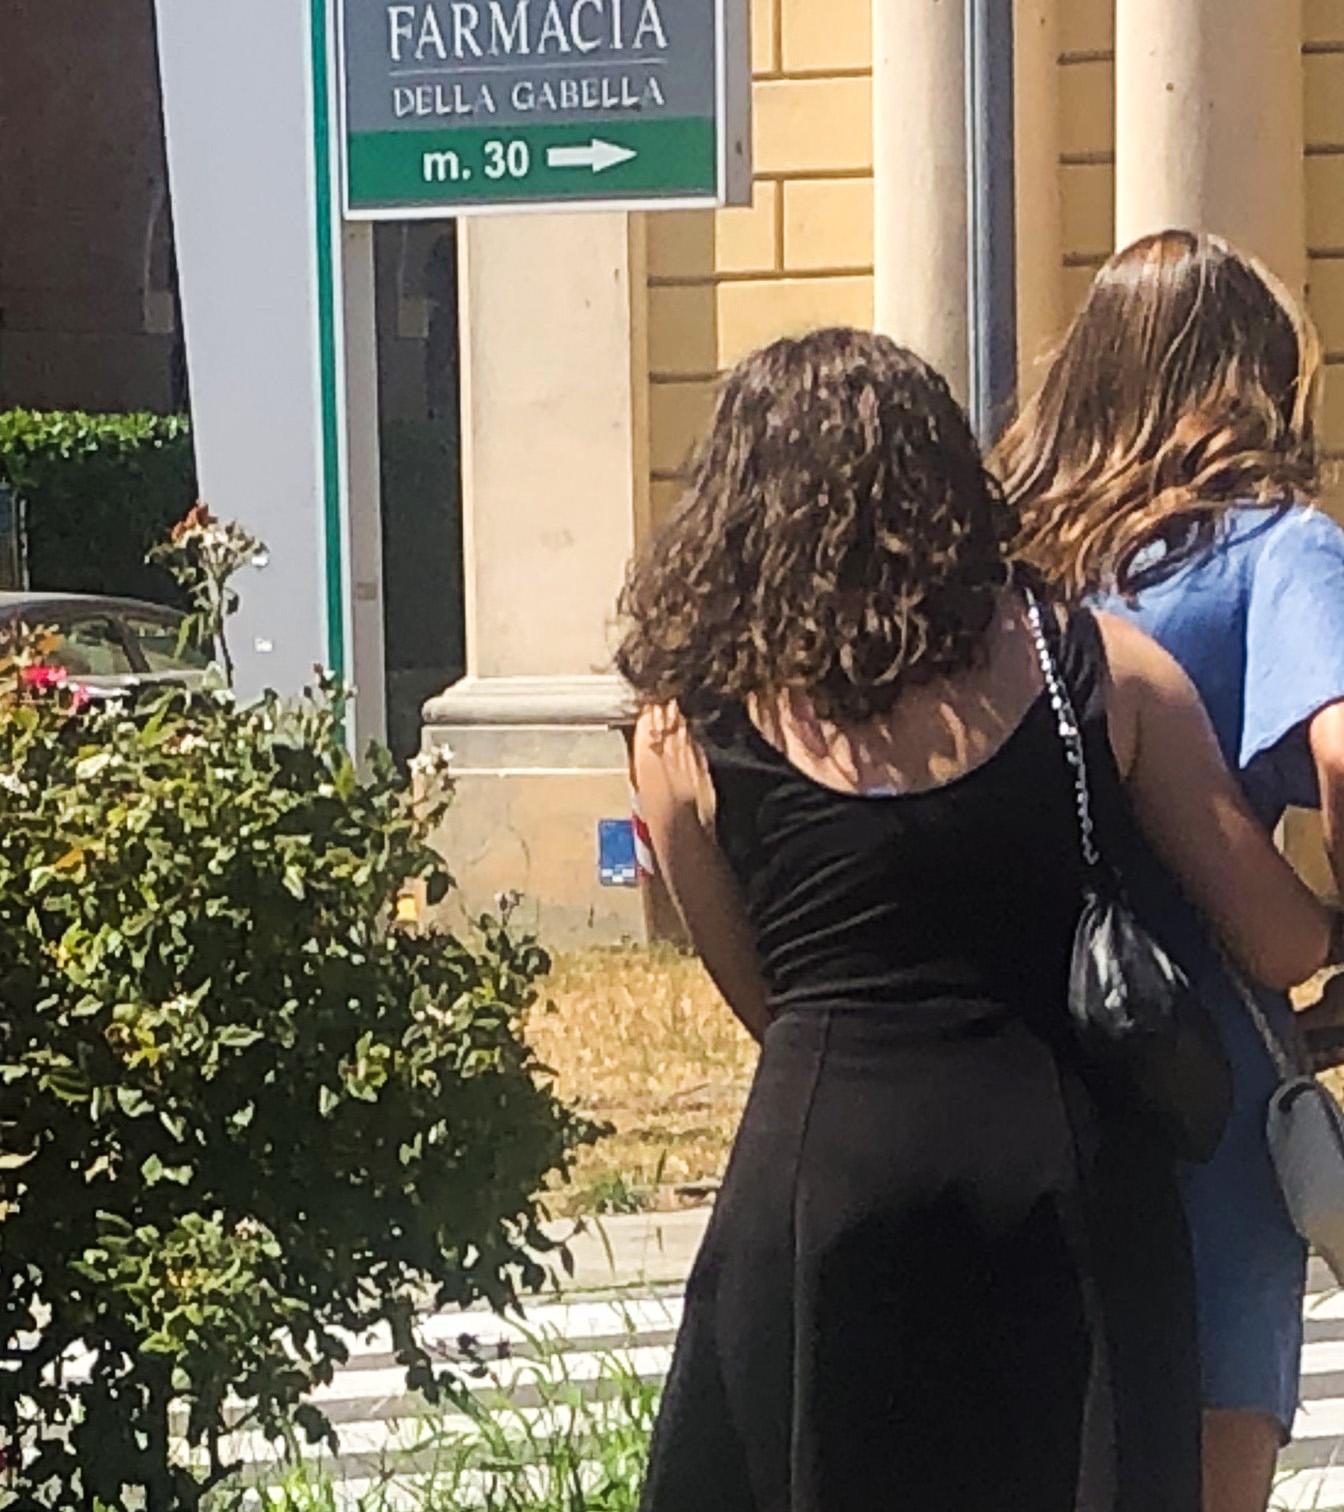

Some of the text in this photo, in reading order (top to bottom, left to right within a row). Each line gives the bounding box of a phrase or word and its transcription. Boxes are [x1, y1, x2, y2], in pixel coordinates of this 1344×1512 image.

[387, 0, 668, 61] FARMACIA
[394, 77, 665, 117] DELLA GABELLA
[423, 140, 530, 182] m. 30
